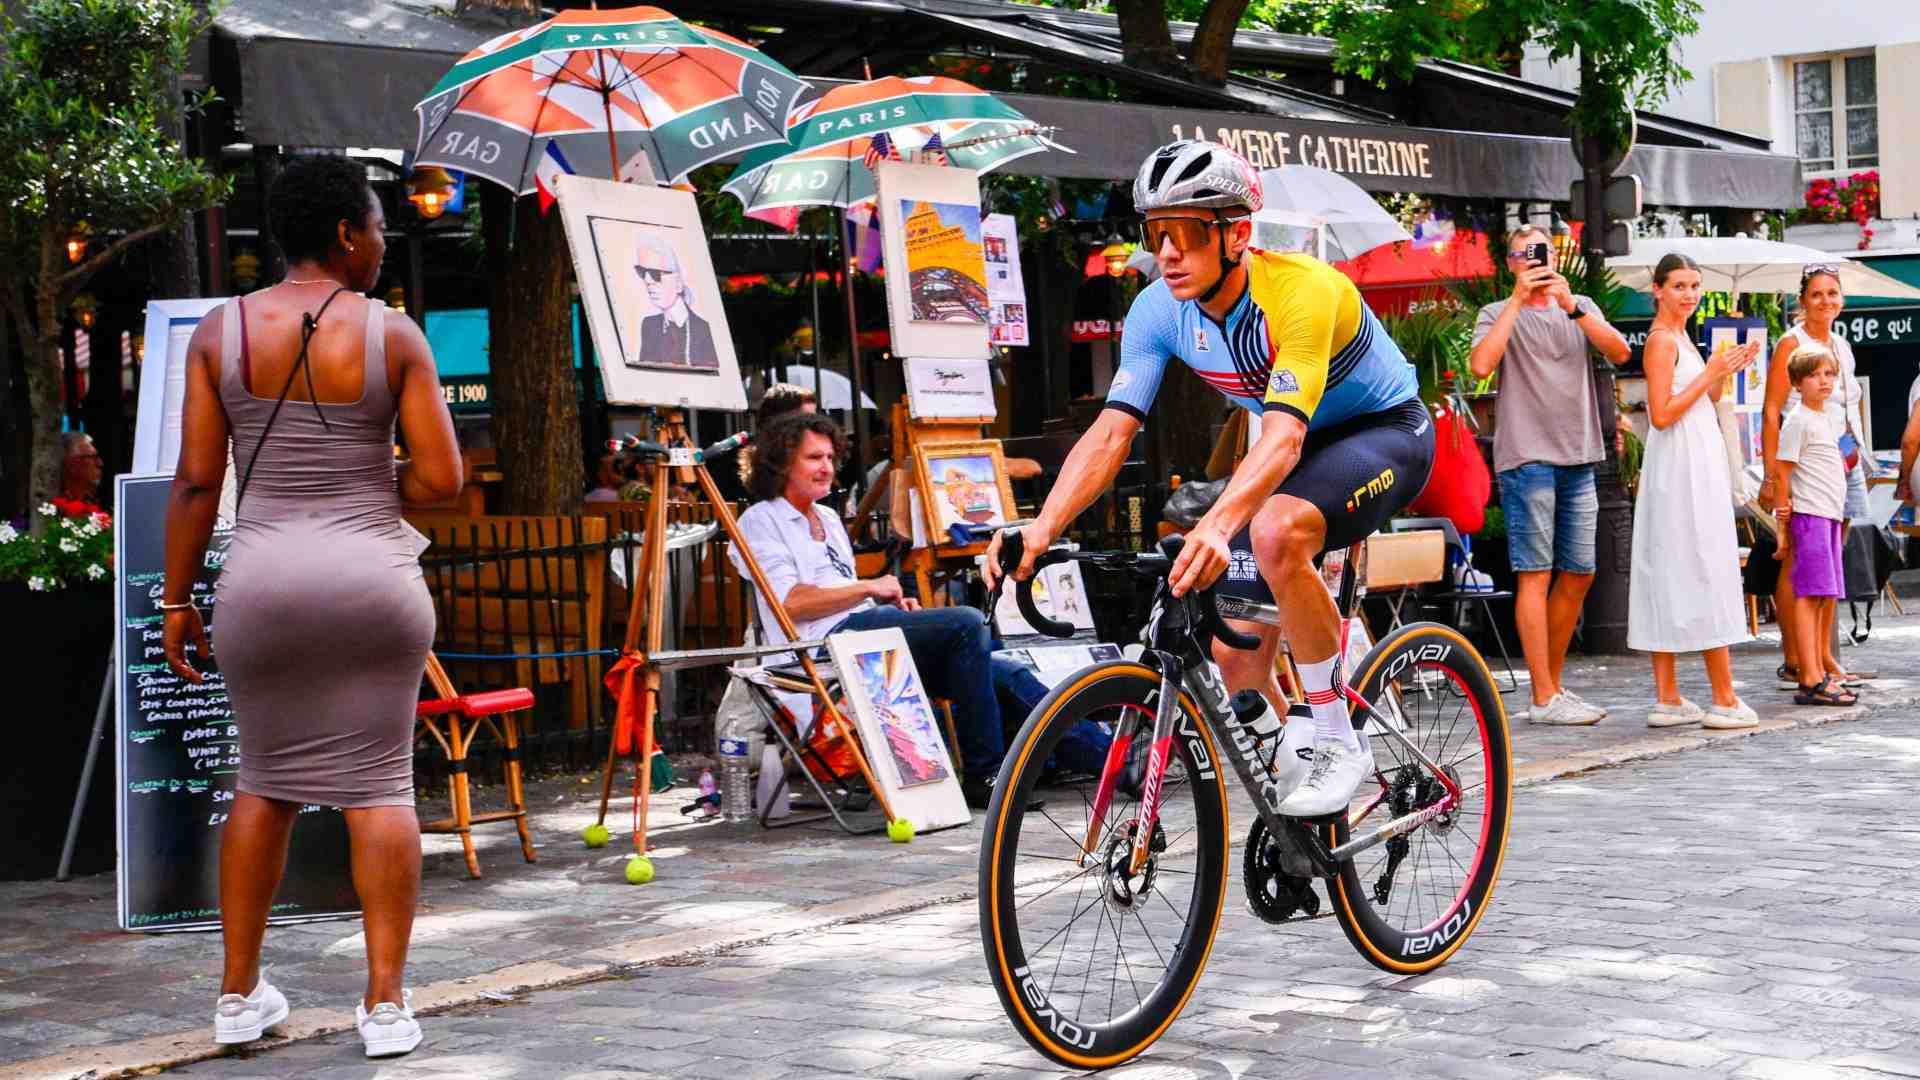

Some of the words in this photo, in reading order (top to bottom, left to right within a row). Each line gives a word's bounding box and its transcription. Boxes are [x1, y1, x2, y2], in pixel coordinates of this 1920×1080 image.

[566, 30, 669, 44] PARIS
[818, 105, 907, 134] PARIS
[1299, 133, 1433, 179] CATHERINE
[1887, 315, 1913, 340] qui
[459, 384, 487, 403] 1900
[1379, 644, 1452, 693] roval
[1143, 688, 1216, 780] rval
[1401, 899, 1471, 956] roval
[1014, 966, 1097, 1050] roval
